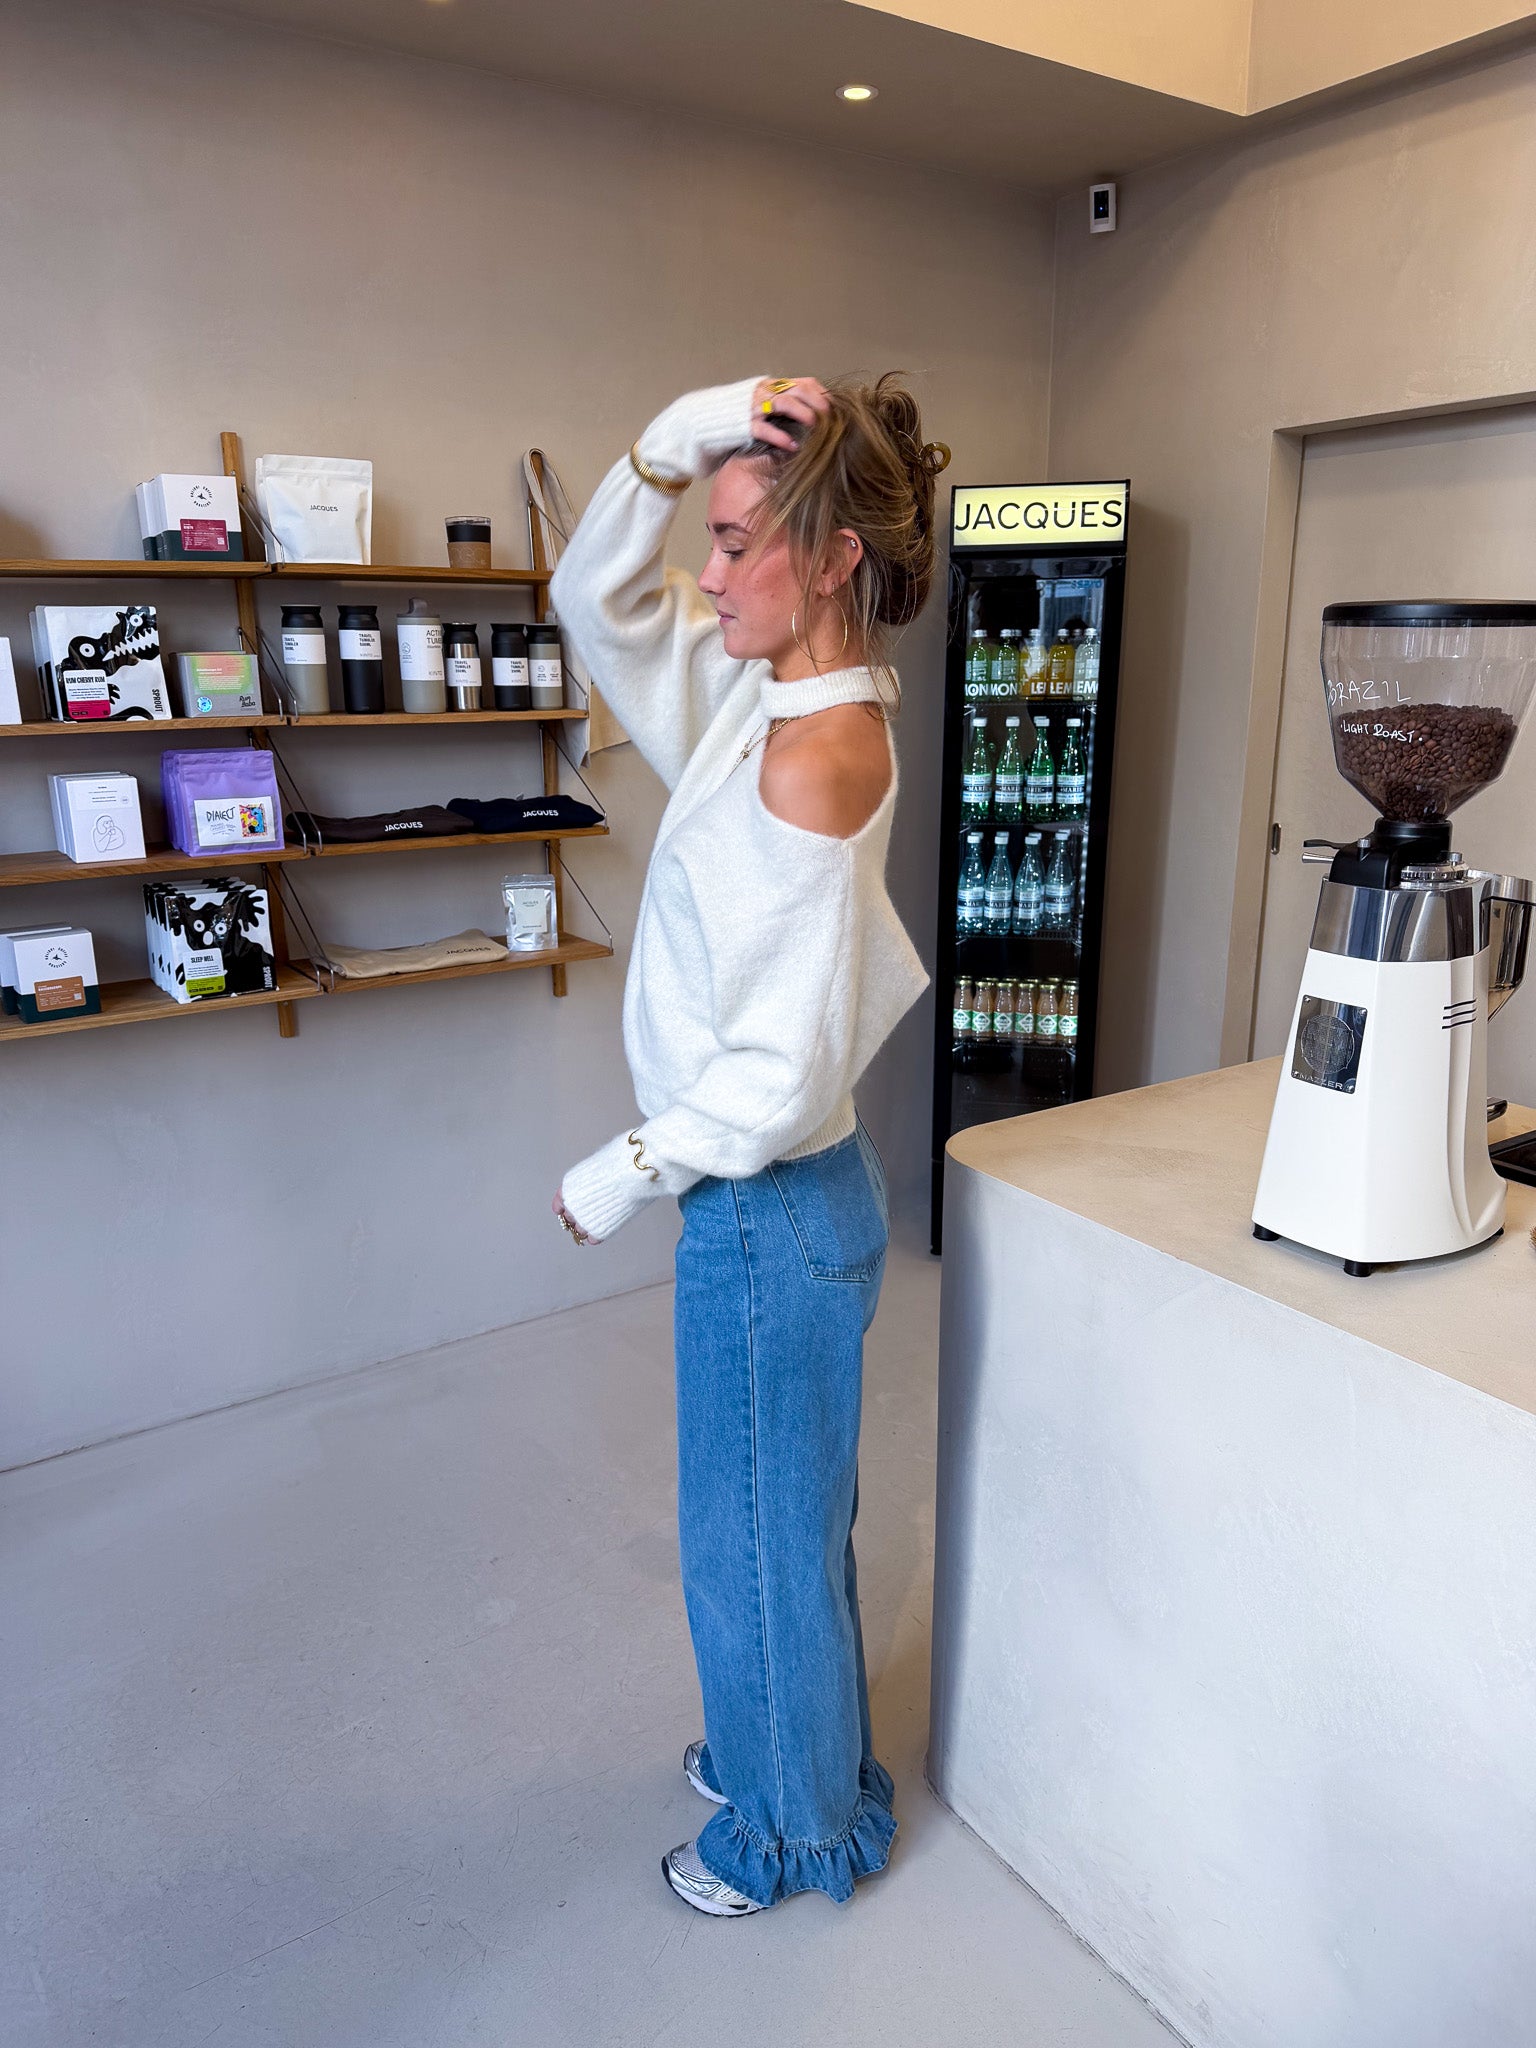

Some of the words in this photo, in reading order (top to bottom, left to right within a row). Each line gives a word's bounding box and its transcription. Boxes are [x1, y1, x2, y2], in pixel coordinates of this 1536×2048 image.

[309, 504, 339, 512] JACQUES
[955, 499, 1123, 531] JACQUES
[77, 676, 95, 684] CHERRY
[1031, 682, 1046, 695] LE
[1327, 680, 1411, 706] BRAZIL
[152, 689, 163, 712] SPROUT
[206, 806, 236, 822] DIALECT
[522, 809, 559, 818] JACQUES
[384, 821, 424, 832] JACQUES
[190, 956, 203, 964] SLEEP
[263, 966, 273, 988] SPROUT
[1300, 1073, 1343, 1090] MAZZER
